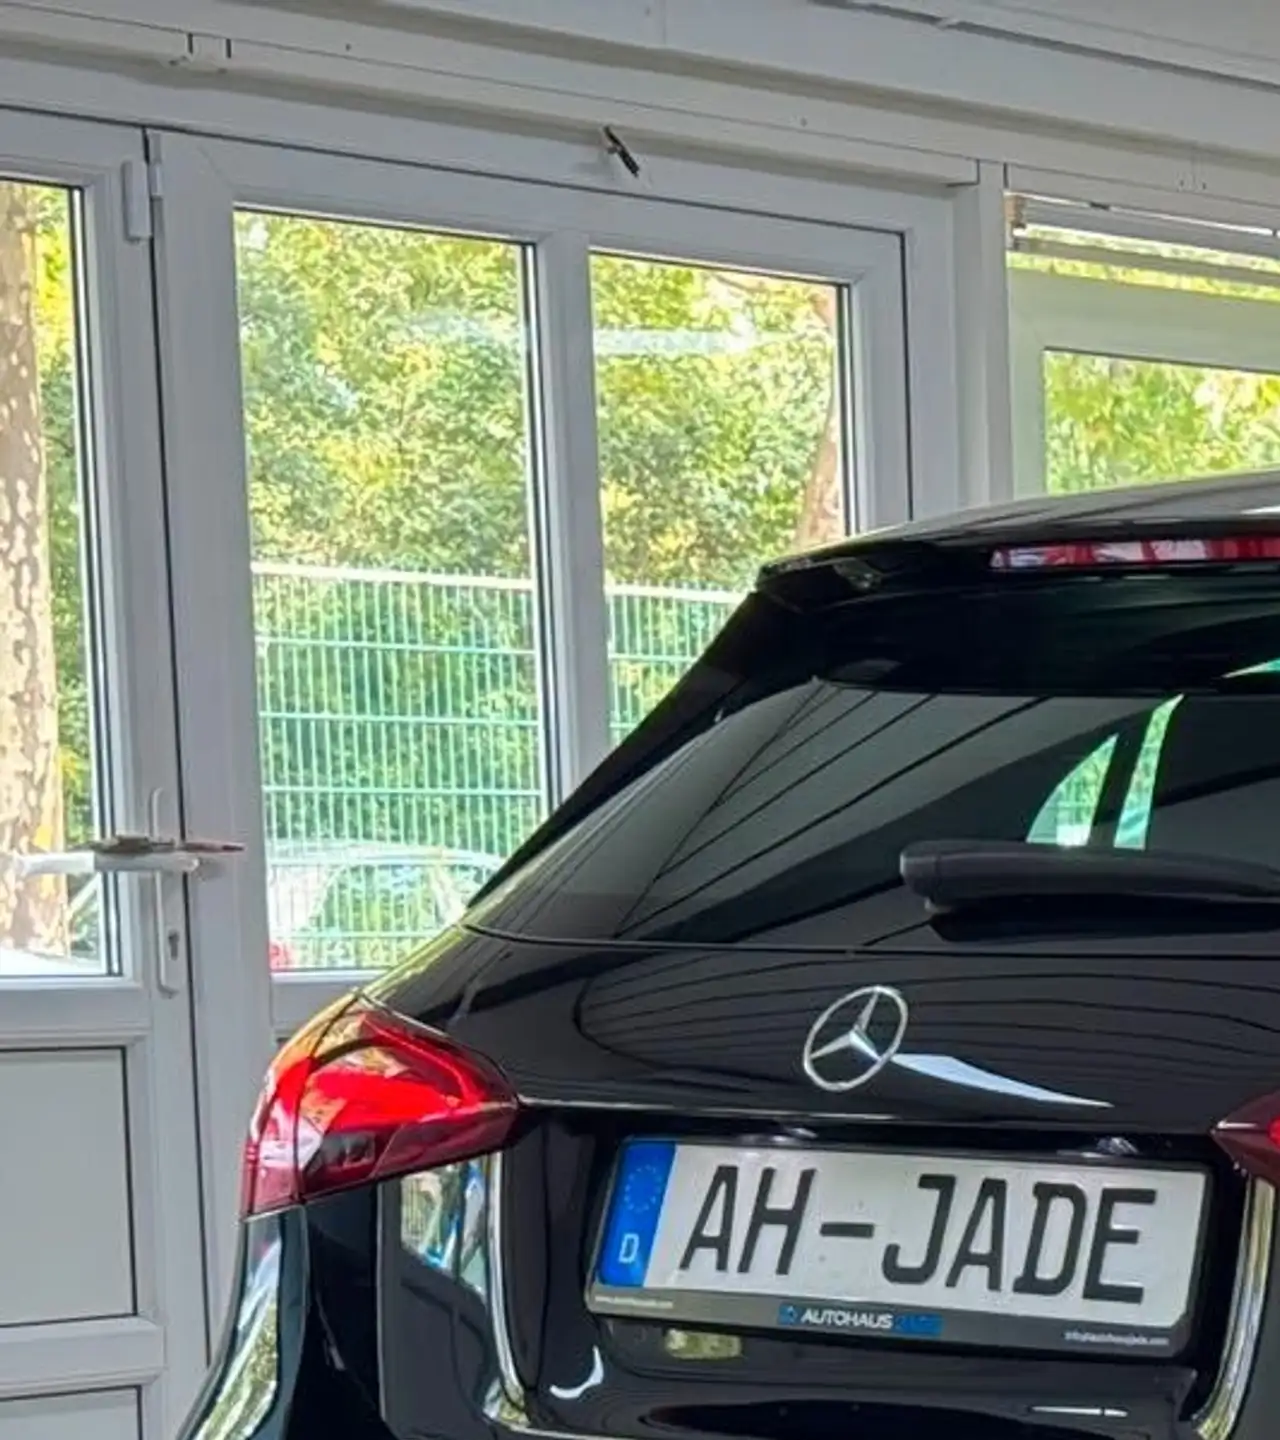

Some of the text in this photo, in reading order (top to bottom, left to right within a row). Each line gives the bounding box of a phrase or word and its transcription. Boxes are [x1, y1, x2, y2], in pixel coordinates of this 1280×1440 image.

[618, 1234, 639, 1264] D
[680, 1164, 1156, 1305] AH-JADE
[801, 1308, 893, 1330] AUTOHAUS
